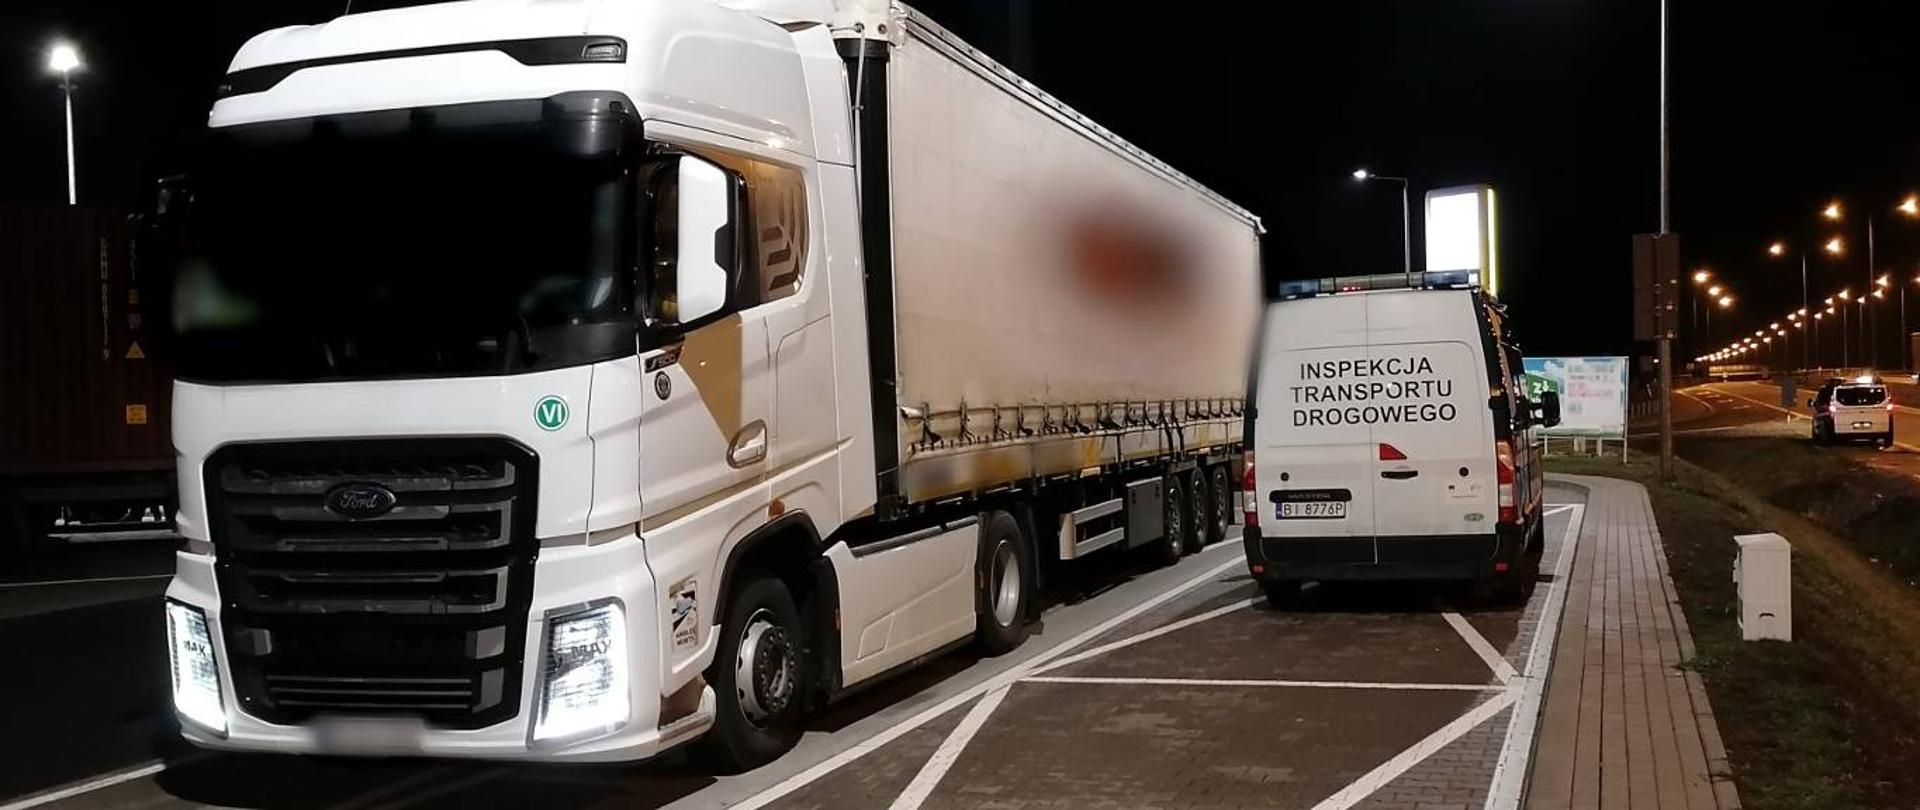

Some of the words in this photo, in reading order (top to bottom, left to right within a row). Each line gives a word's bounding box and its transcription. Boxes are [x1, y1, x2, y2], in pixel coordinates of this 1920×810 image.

[1300, 357, 1434, 380] INSPEKCJA
[1290, 380, 1452, 403] TRANSPORTU
[542, 403, 562, 423] VI
[1293, 403, 1457, 427] DROGOWEGO
[340, 491, 378, 509] Ford
[1283, 503, 1299, 515] BI
[1304, 503, 1343, 515] 8776P
